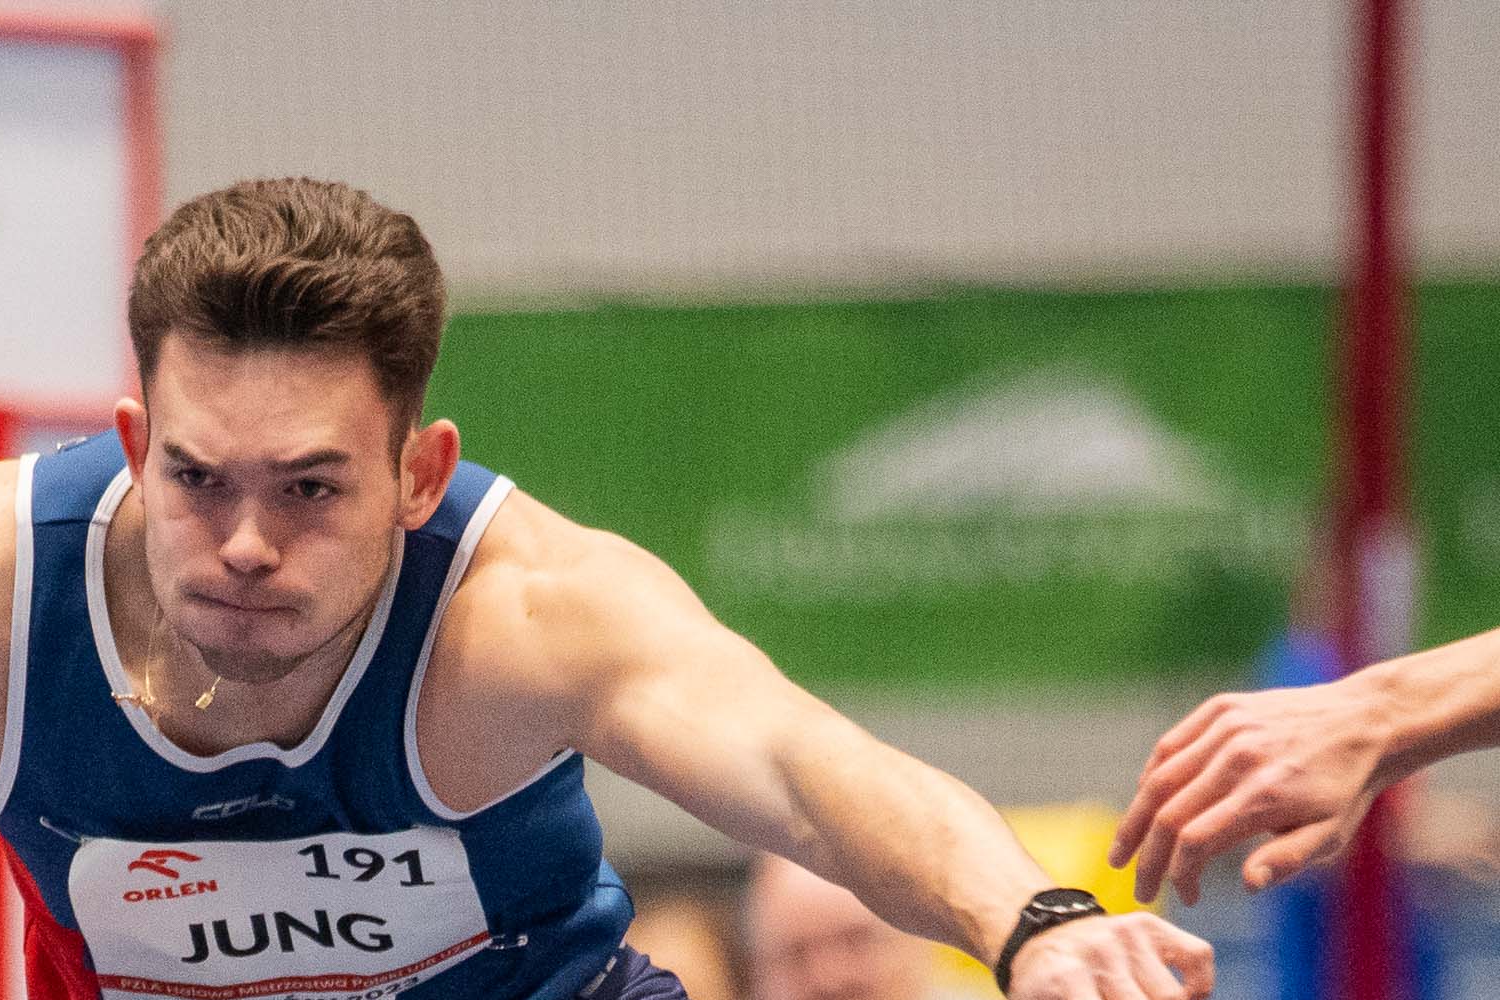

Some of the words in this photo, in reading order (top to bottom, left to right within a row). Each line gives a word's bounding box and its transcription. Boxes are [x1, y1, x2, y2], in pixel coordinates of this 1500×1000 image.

[297, 843, 435, 887] 191
[122, 879, 218, 902] ORLEN
[181, 909, 394, 963] JUNG
